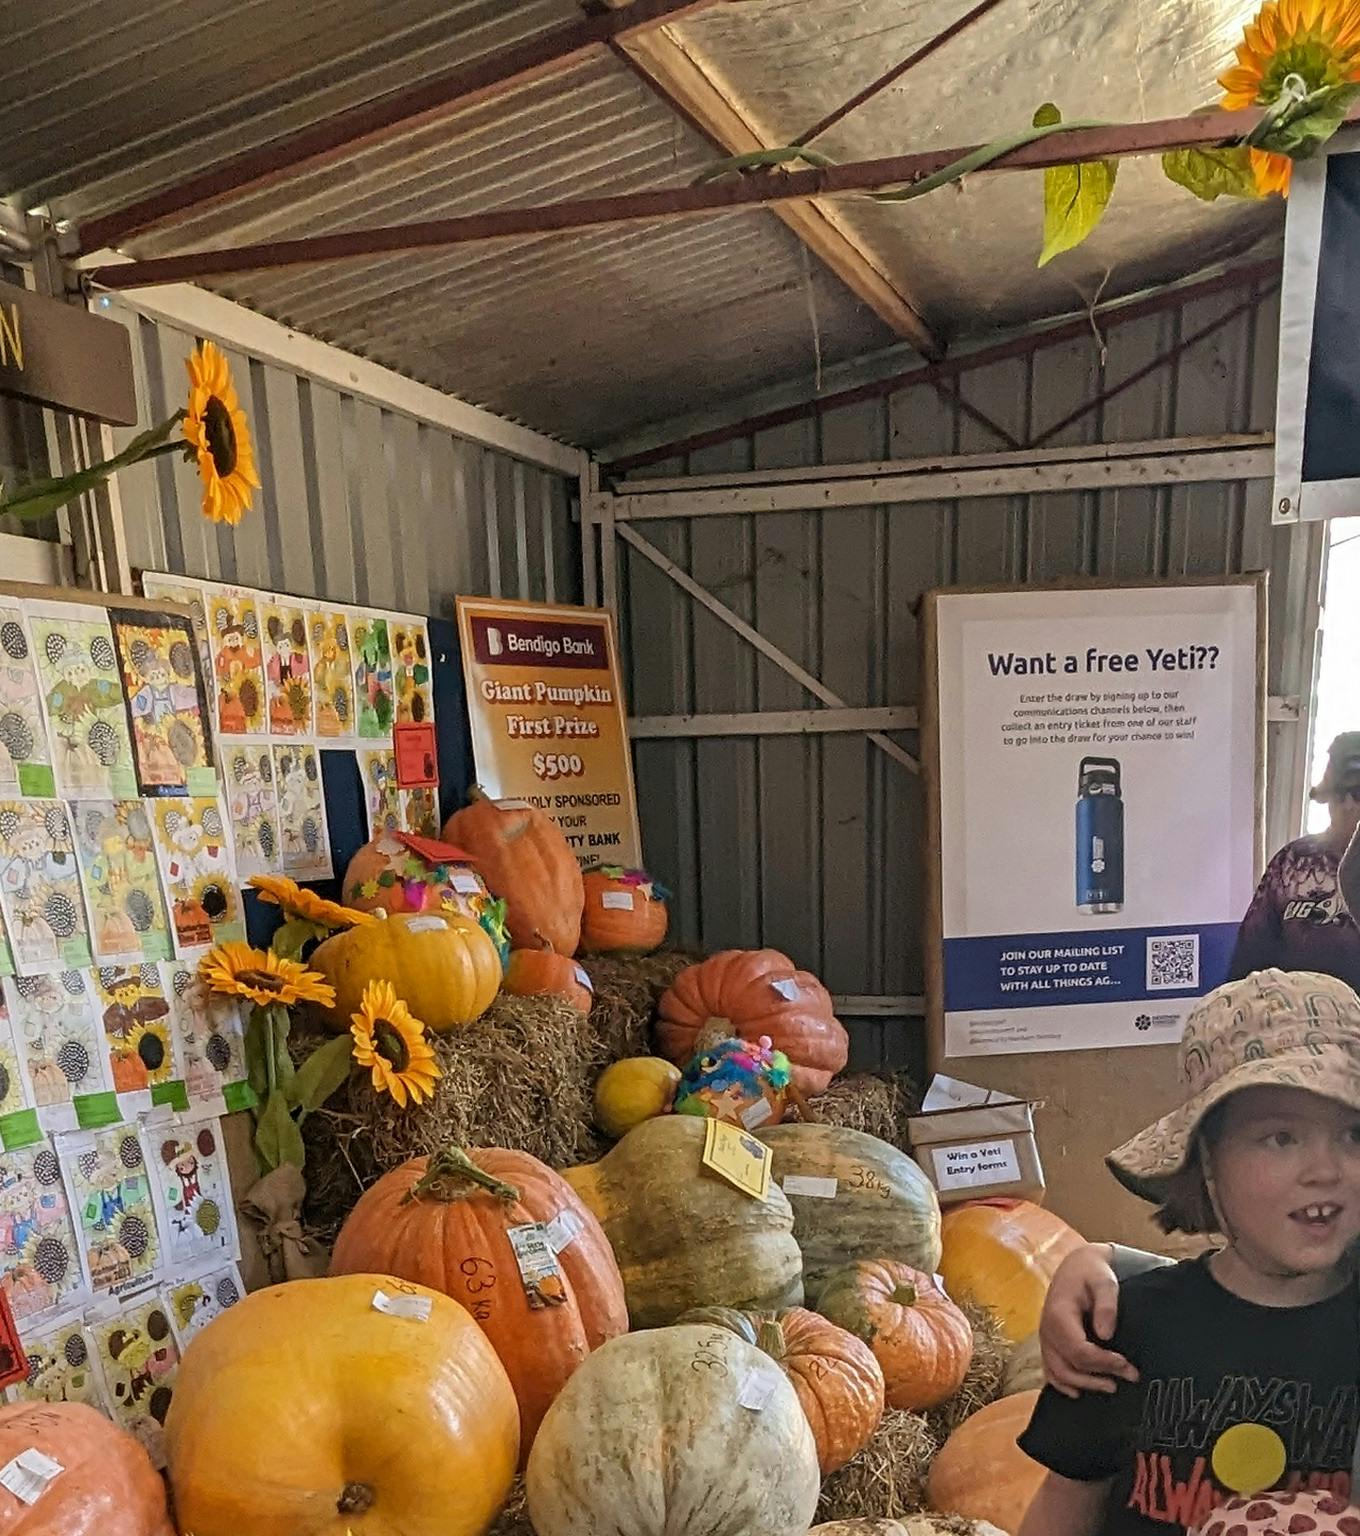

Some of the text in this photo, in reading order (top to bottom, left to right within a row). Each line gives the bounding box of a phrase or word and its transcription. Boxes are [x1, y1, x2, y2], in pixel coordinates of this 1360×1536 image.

[508, 634, 561, 657] Bendigo
[563, 636, 594, 656] Bank
[988, 645, 1220, 676] Want a free Yeti??
[481, 681, 613, 707] Giant Pumpkin
[1047, 693, 1063, 702] the
[1065, 693, 1089, 702] draw
[1090, 692, 1101, 703] by
[1103, 691, 1136, 704] signing
[1152, 690, 1162, 700] to
[1163, 690, 1180, 700] our
[1013, 707, 1089, 718] communications
[1090, 705, 1130, 715] channels
[1164, 703, 1185, 713] then
[506, 715, 598, 737] First Prize
[1034, 722, 1046, 731] an
[1047, 720, 1072, 732] entry
[1074, 719, 1100, 729] ticket
[1102, 719, 1125, 728] from
[1146, 717, 1156, 727] of
[1158, 717, 1174, 727] our
[1176, 716, 1197, 726] staff
[1003, 736, 1014, 745] to
[1015, 737, 1028, 747] go
[1050, 734, 1066, 744] the
[1067, 732, 1091, 743] draw
[1092, 732, 1106, 742] for
[1108, 732, 1129, 744] your
[533, 751, 583, 779] $500
[555, 792, 621, 808] SPONSORED
[557, 816, 587, 827] YOUR
[589, 832, 621, 847] BANK
[1000, 944, 1125, 962] JOIN OUR MAILING LIST
[1000, 960, 1108, 977] TO STAY UP TO DATE
[1000, 975, 1122, 992] WITH ALL THINGS AG...
[947, 1147, 1001, 1162] Win a Yeti
[946, 1160, 1008, 1176] Entry forms
